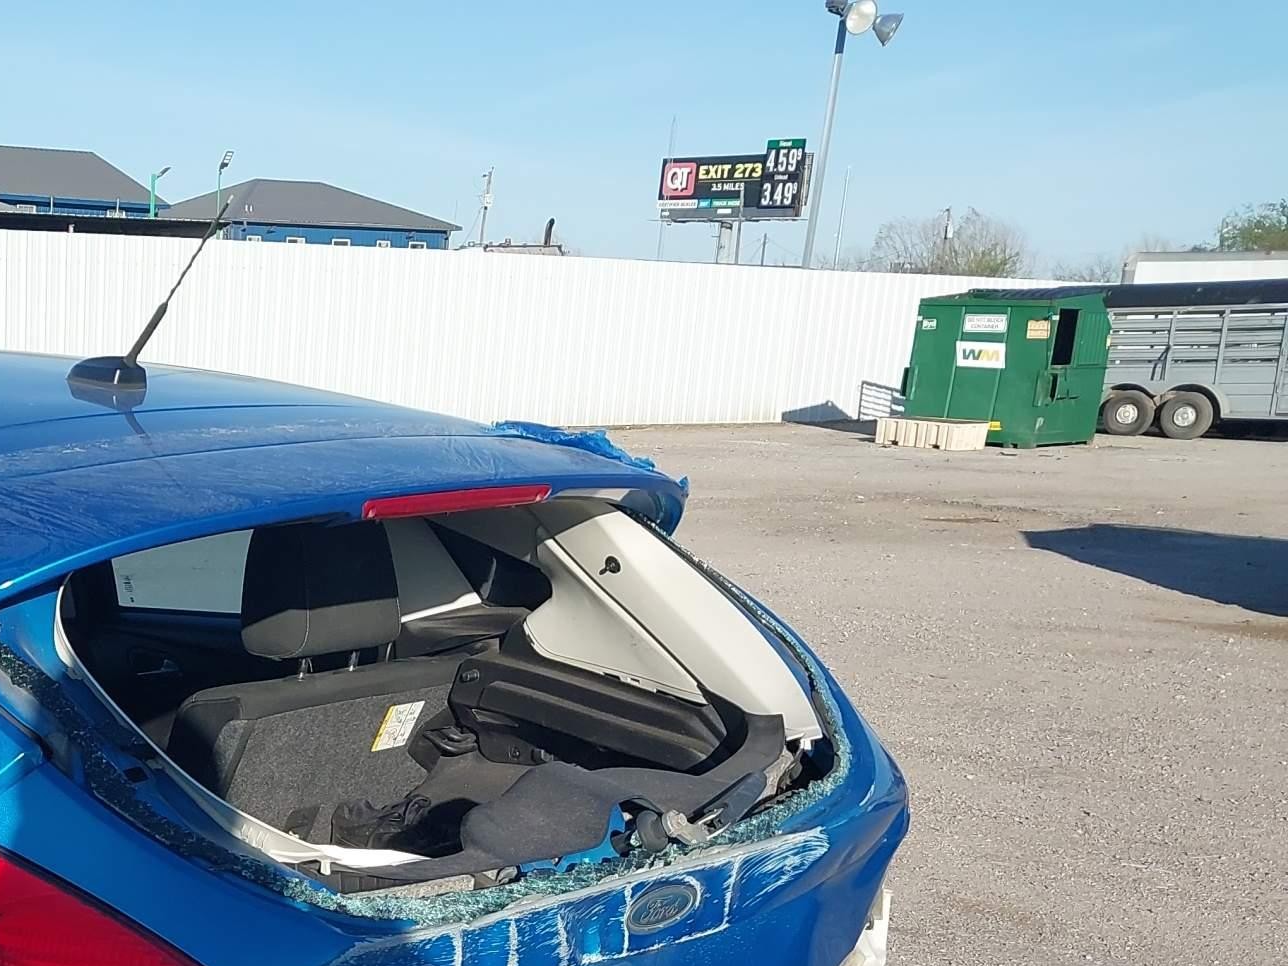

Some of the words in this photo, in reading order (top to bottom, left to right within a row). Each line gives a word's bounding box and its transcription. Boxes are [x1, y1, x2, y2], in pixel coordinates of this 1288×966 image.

[666, 167, 692, 191] QT
[698, 164, 732, 180] EXIT
[733, 162, 763, 179] 273
[723, 182, 745, 191] MILES
[962, 348, 1000, 362] WM
